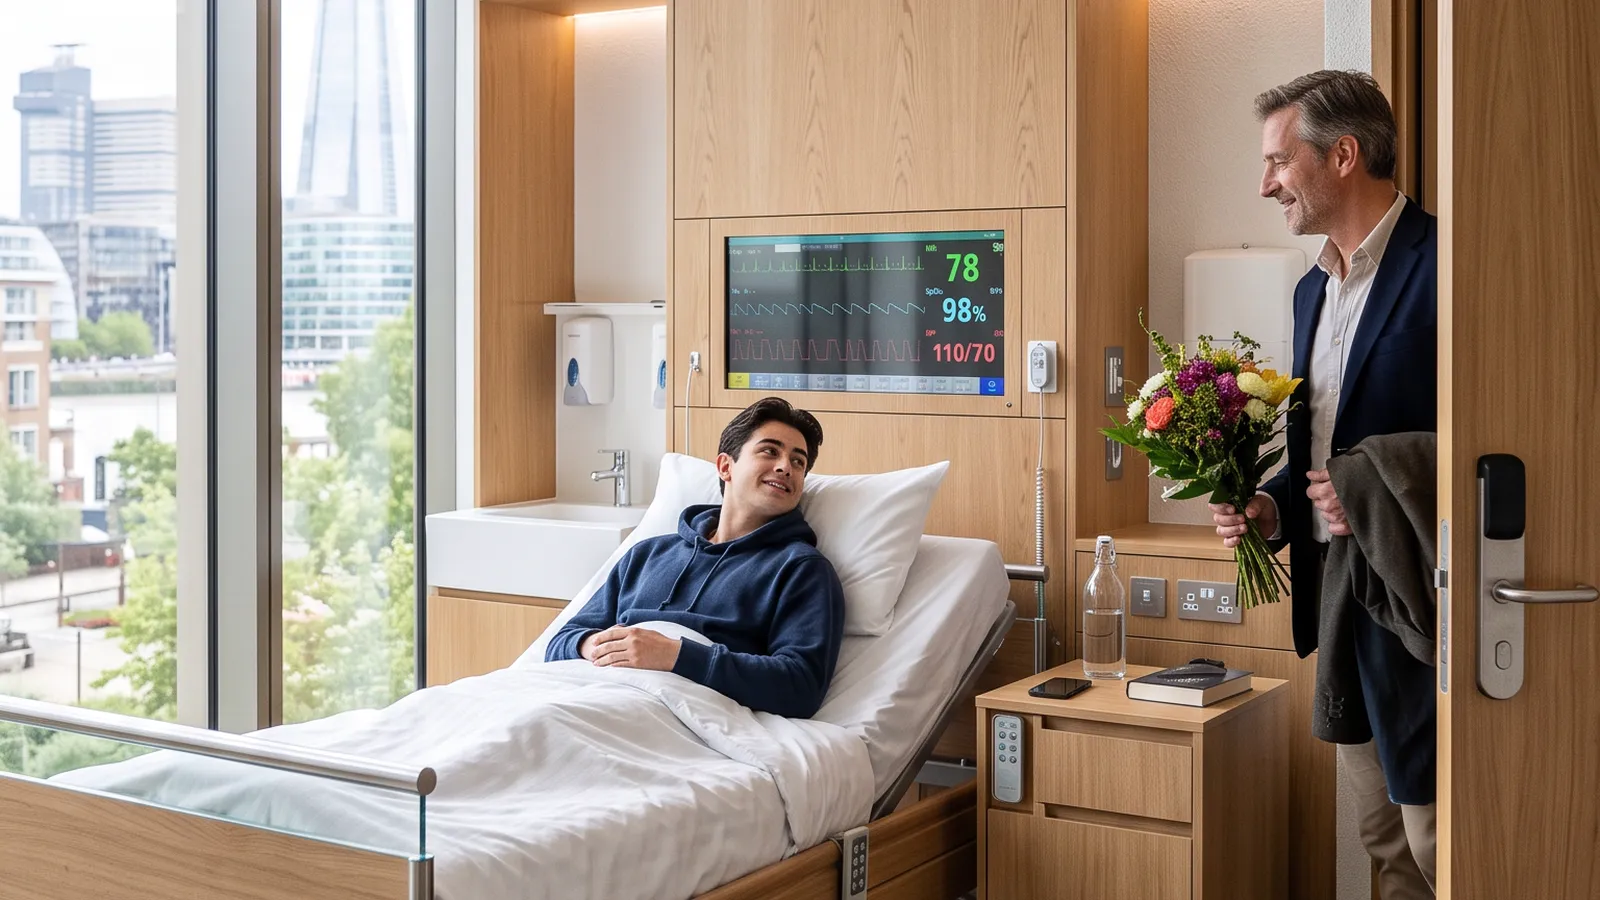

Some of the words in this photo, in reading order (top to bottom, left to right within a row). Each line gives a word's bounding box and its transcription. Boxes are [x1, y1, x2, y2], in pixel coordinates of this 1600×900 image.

[946, 253, 980, 283] 78
[942, 297, 987, 323] 98%
[933, 342, 996, 363] 110/70
